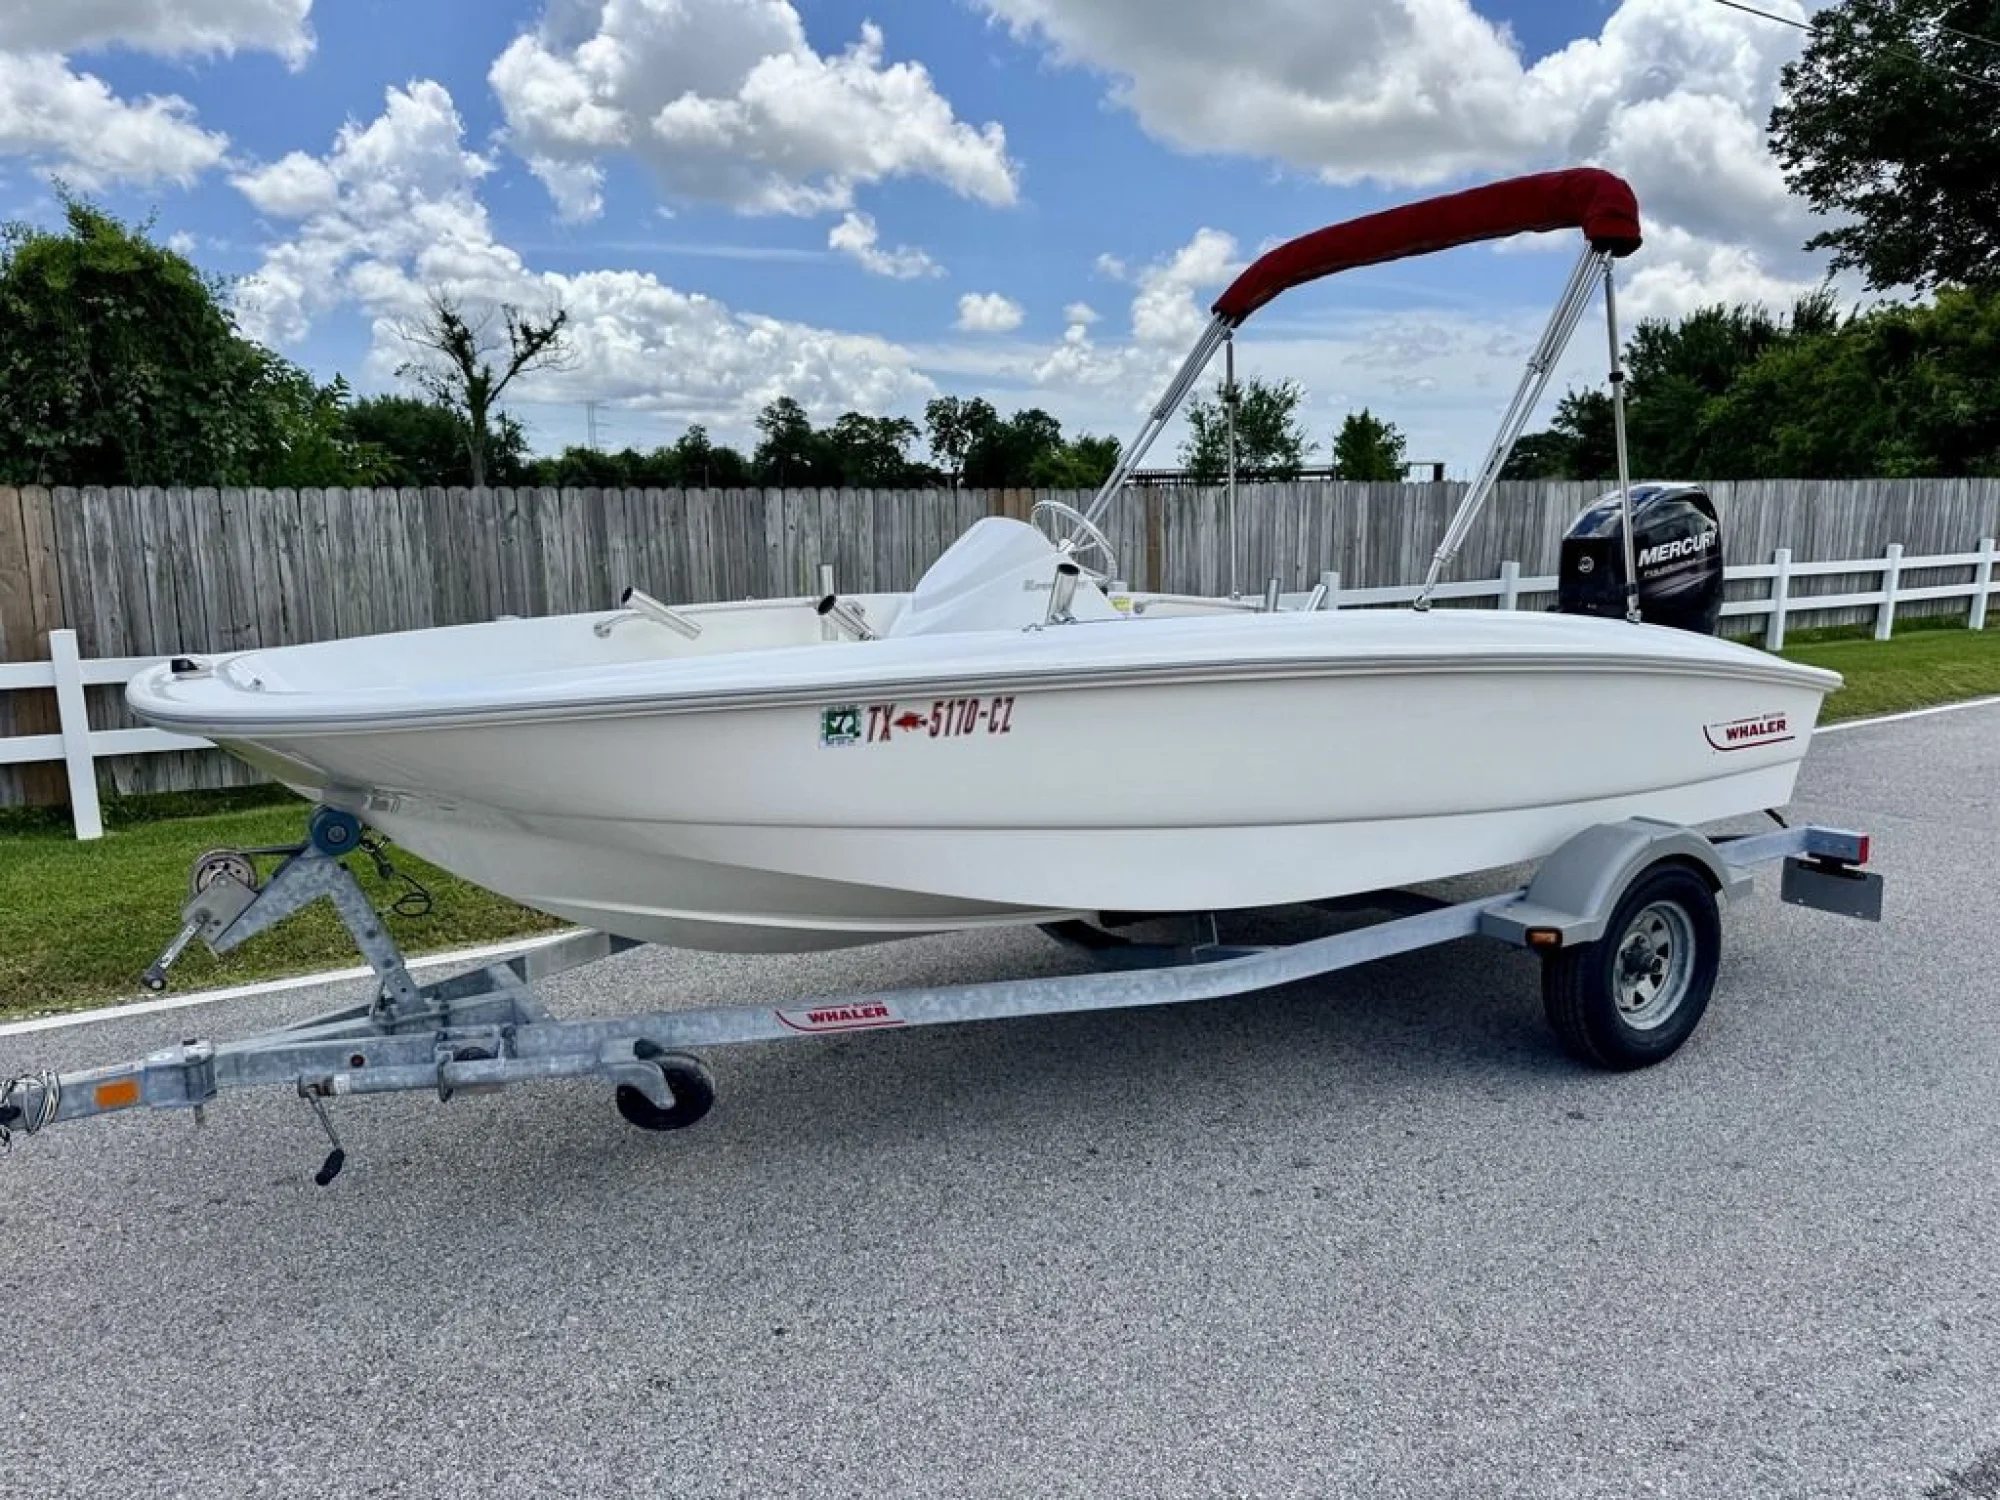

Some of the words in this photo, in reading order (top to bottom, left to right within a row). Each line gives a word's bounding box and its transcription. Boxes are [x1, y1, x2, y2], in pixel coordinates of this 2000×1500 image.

[866, 703, 897, 743] TX
[929, 696, 1015, 738] 5170-CZ
[1725, 719, 1786, 741] WHALER
[806, 1006, 889, 1023] WHALER
